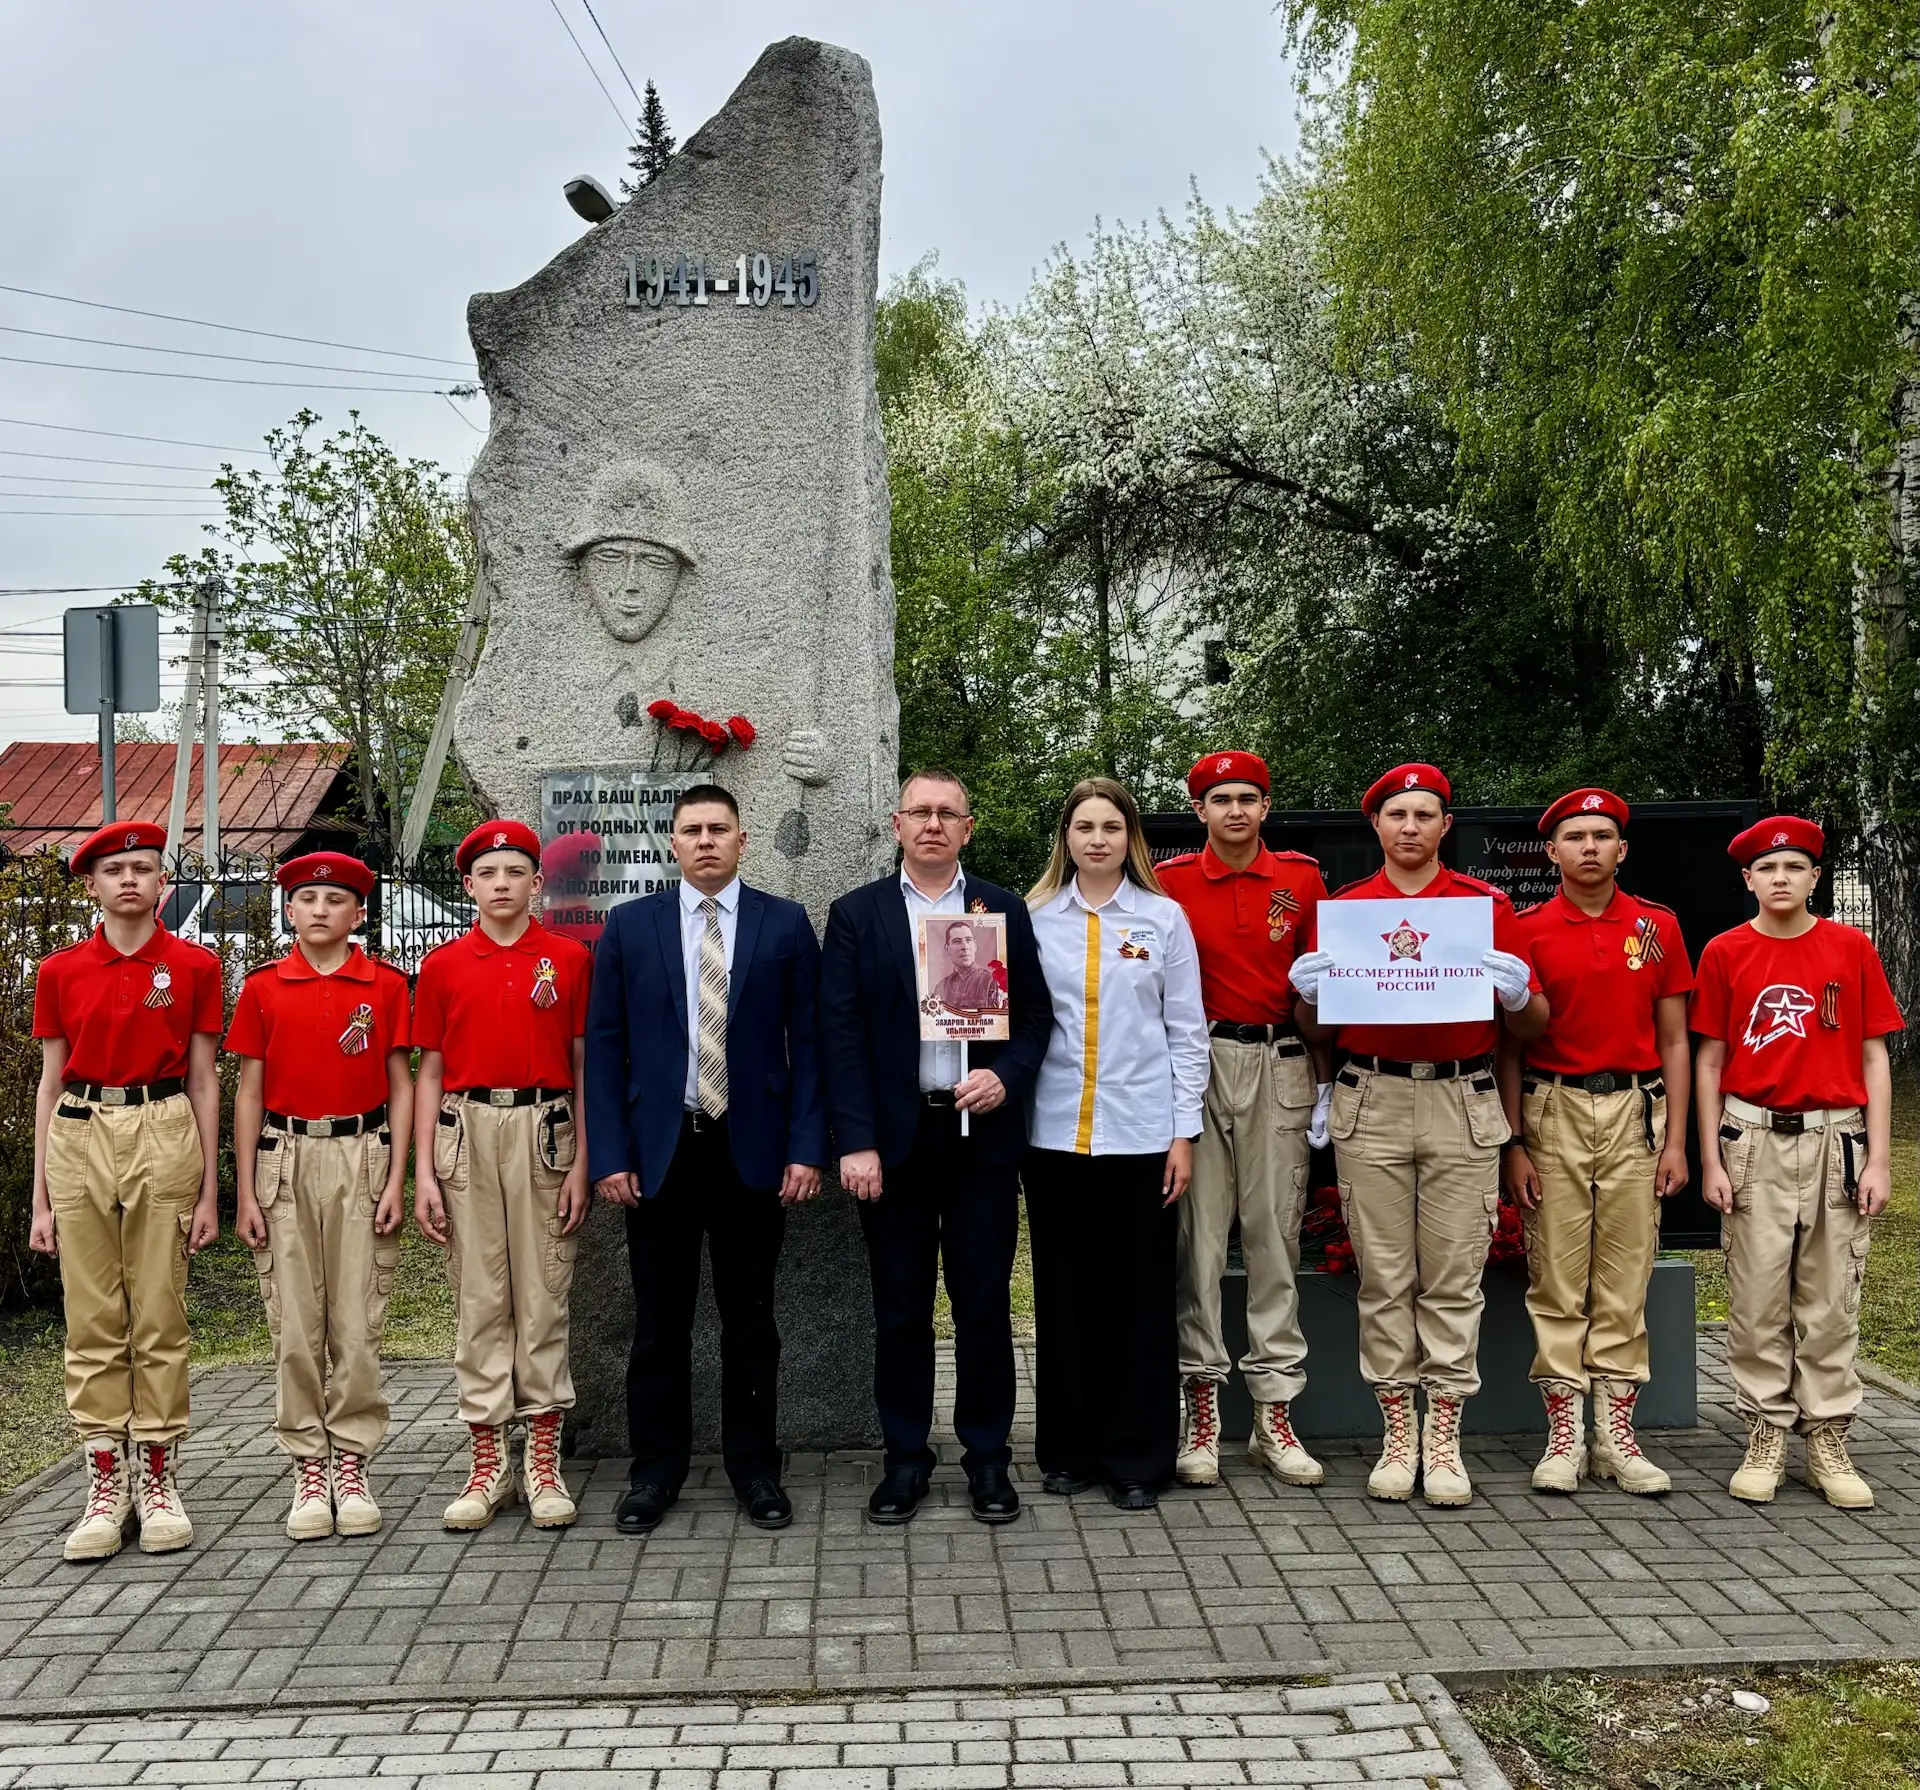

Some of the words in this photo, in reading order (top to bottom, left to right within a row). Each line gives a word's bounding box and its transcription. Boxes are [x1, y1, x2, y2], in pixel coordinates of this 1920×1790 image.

[625, 252, 819, 307] 1941-1945
[552, 790, 593, 805] ПРАХ
[600, 790, 634, 804] ВАШ
[639, 789, 687, 806] ДАЛЕ
[557, 820, 576, 835] ОТ
[581, 819, 649, 836] РОДНЫХ
[606, 849, 662, 864] ИМЕНА
[1466, 865, 1541, 881] Бородулин
[566, 880, 640, 897] ПОДВИГИ
[645, 880, 681, 894] ВАШ
[1328, 966, 1439, 978] БЕССМЕРТНЫЙ
[1443, 967, 1485, 978] ПОЛК
[1376, 981, 1436, 991] РОССИИ
[935, 1018, 965, 1026] ЗАХАРОВ
[967, 1018, 994, 1026] ХАРЛАМ
